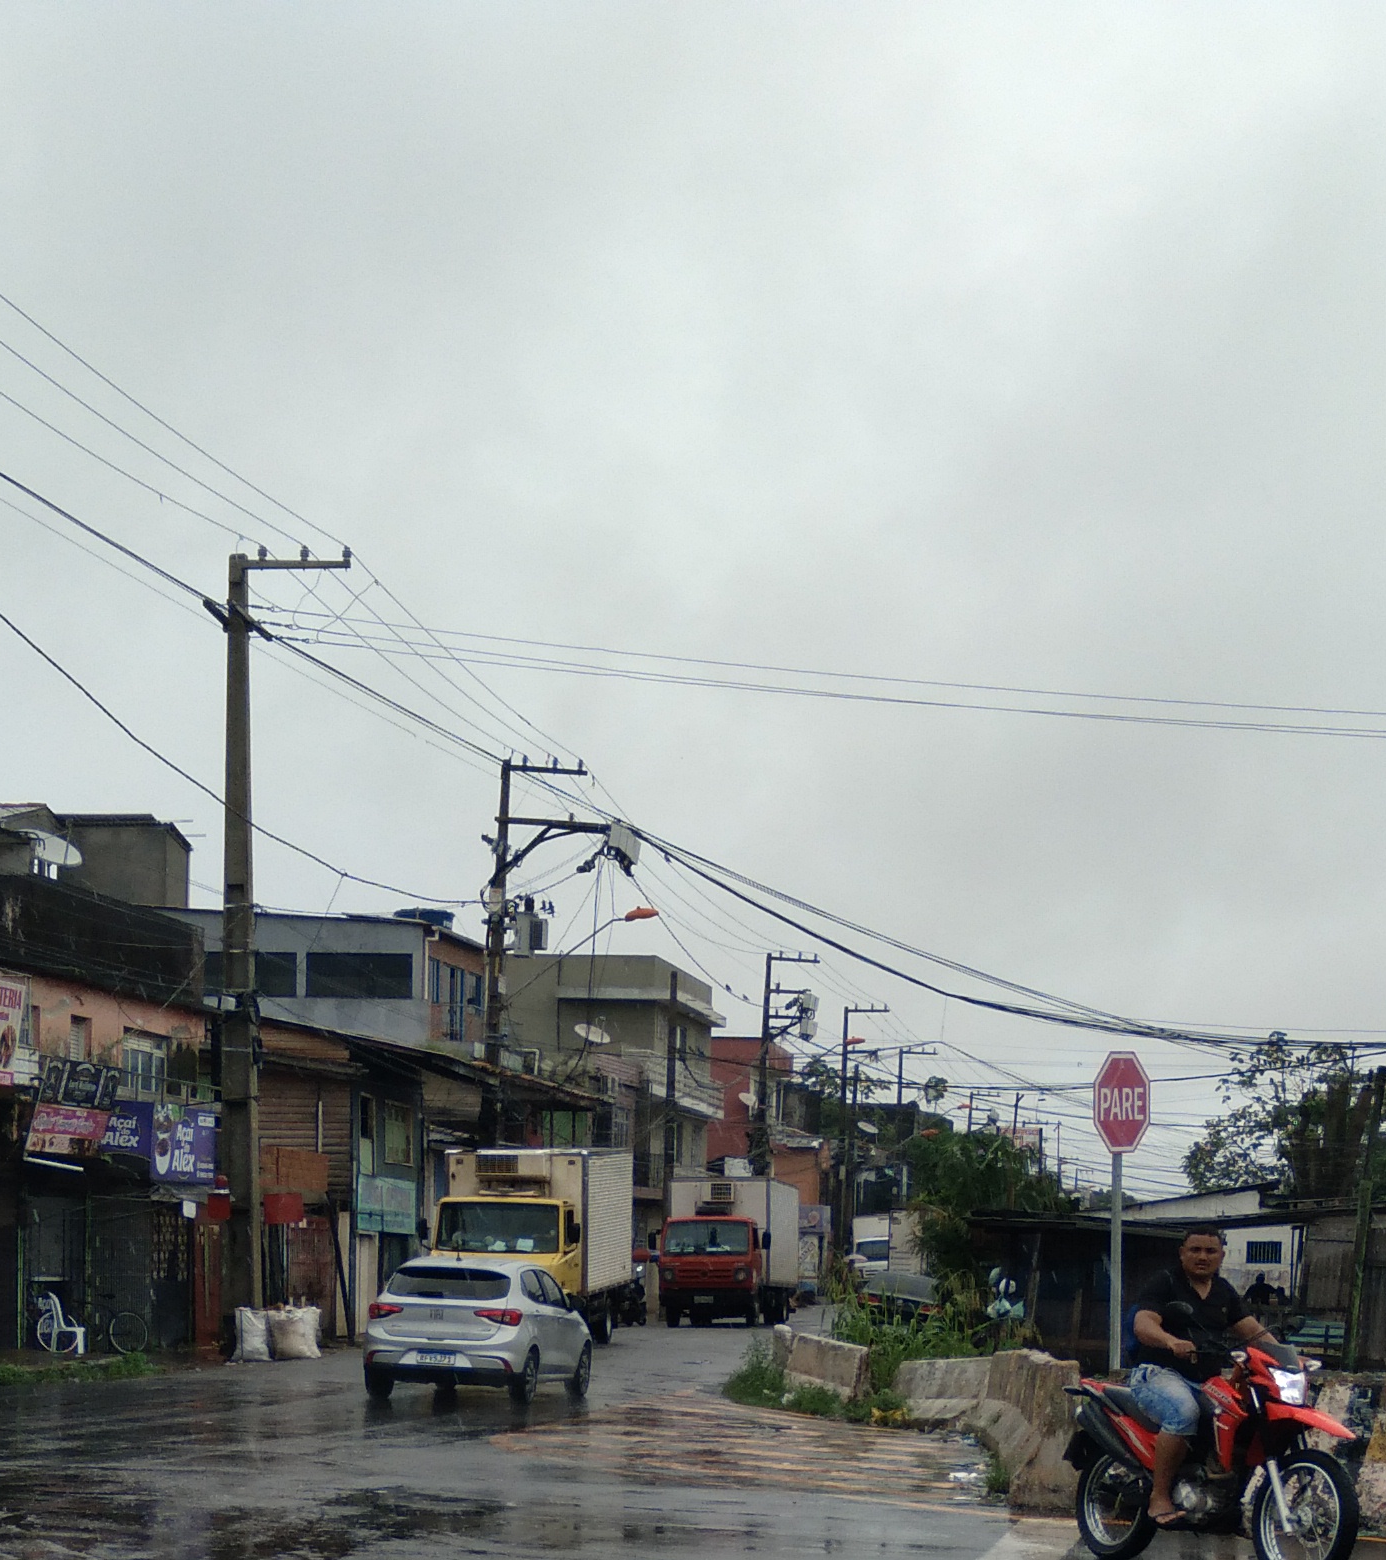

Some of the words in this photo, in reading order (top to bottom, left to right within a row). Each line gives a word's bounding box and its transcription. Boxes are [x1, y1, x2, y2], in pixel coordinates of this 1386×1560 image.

[1100, 1087, 1144, 1121] PARE
[109, 1116, 138, 1131] Açaí
[176, 1123, 195, 1147] Açaí
[101, 1132, 140, 1148] Alex
[172, 1149, 196, 1173] Alex
